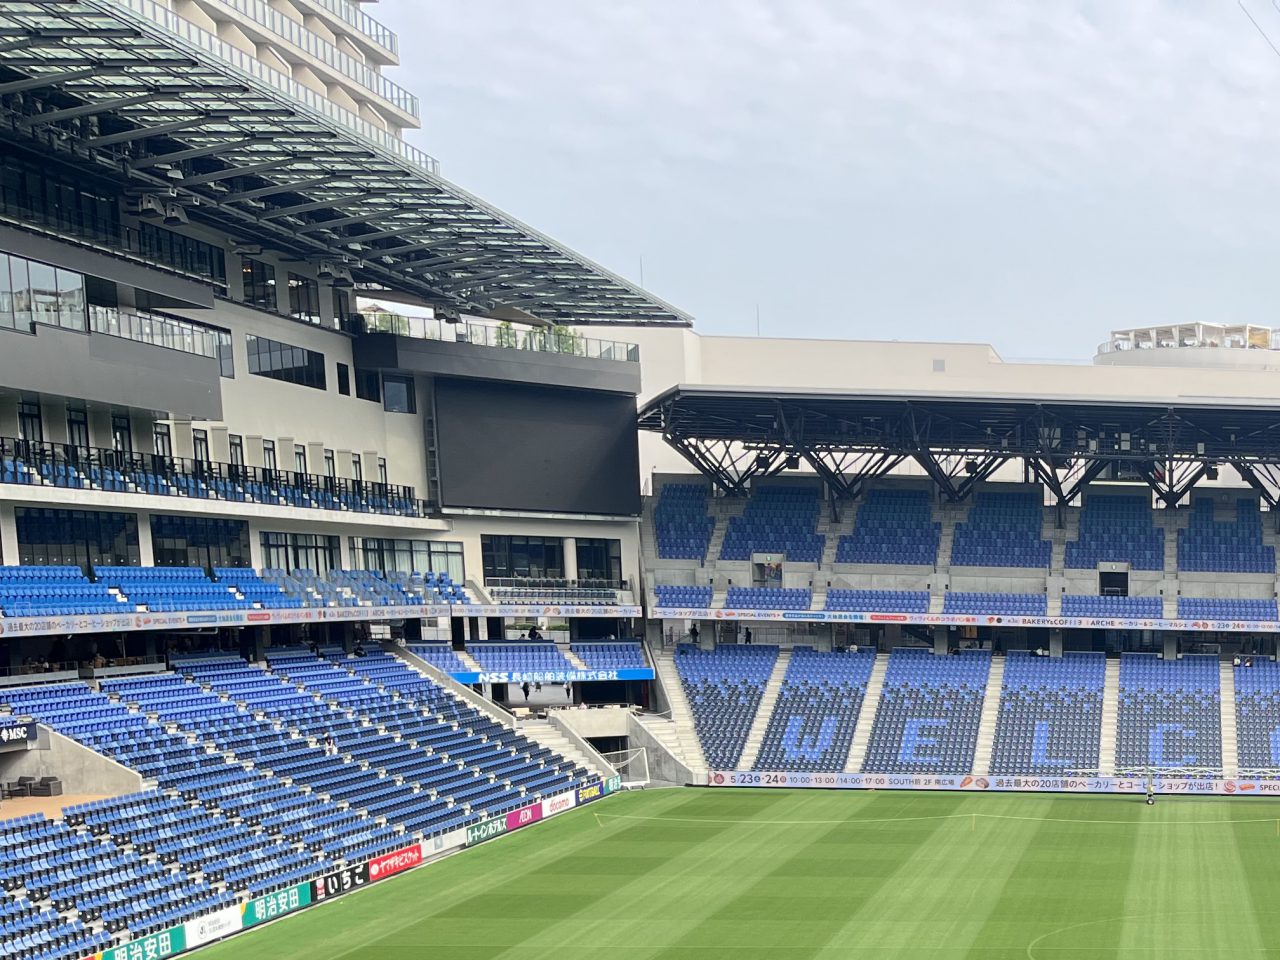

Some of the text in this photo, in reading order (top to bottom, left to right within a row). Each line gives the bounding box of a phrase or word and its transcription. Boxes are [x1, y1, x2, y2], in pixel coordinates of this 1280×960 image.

[478, 672, 509, 683] NSS
[8, 727, 27, 740] MSC
[326, 863, 365, 894] いちご
[254, 888, 299, 920] 明治安田
